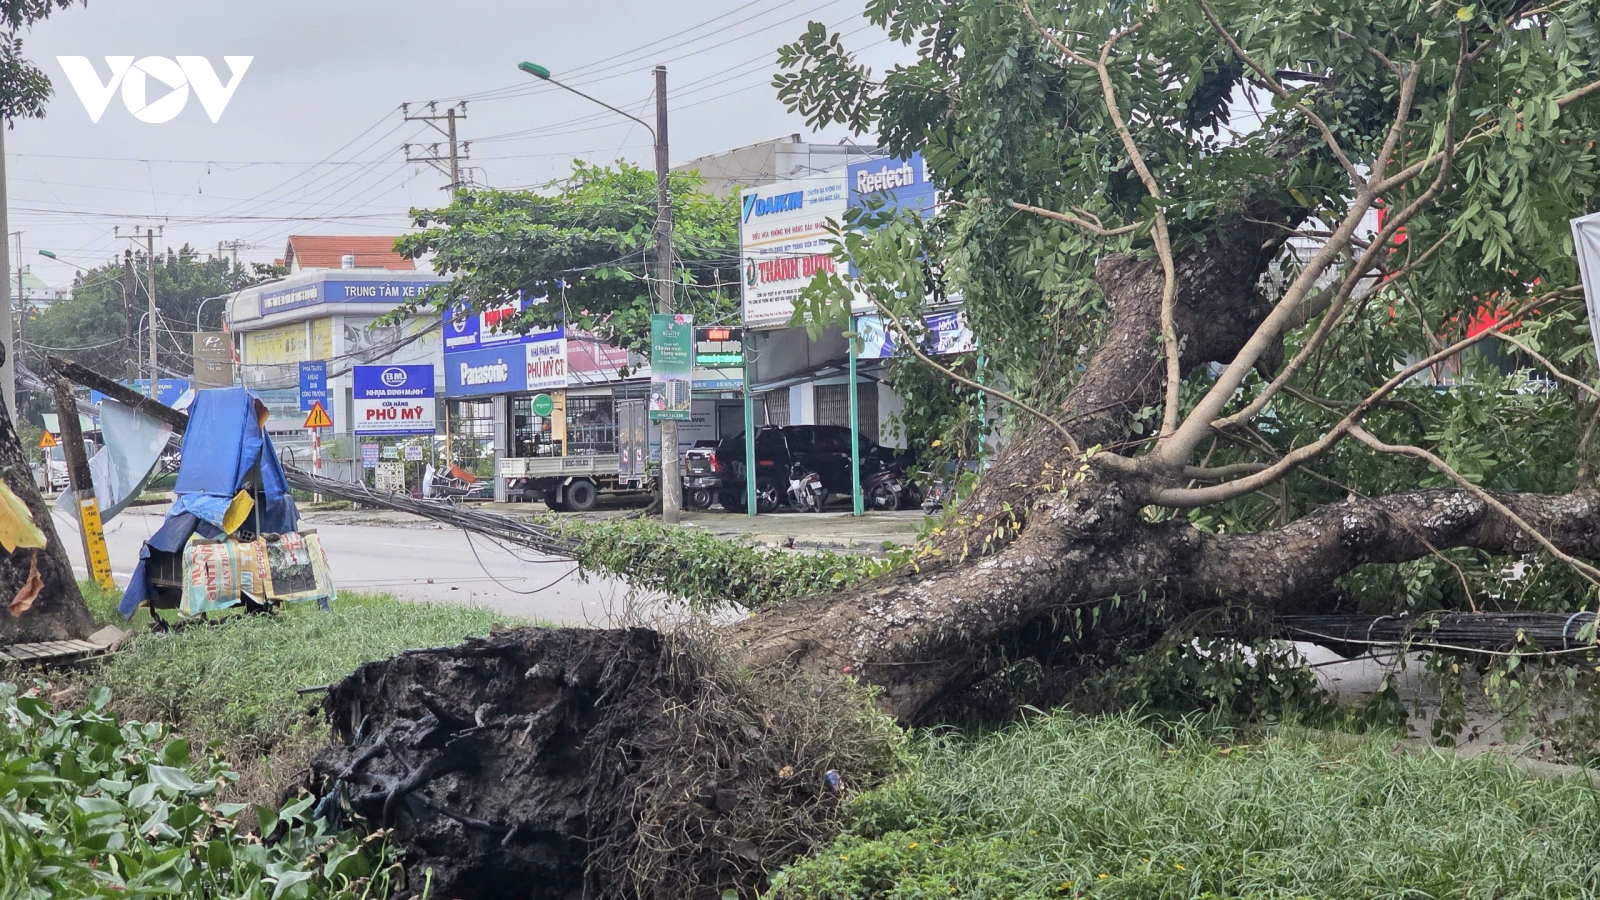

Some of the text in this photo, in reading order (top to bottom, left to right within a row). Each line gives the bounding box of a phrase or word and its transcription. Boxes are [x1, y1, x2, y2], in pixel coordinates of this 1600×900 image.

[857, 161, 914, 193] Reetech
[755, 191, 803, 216] DAIKIN
[344, 286, 376, 296] TRUNG
[379, 284, 399, 296] TÂM
[402, 286, 414, 296] XE
[460, 358, 509, 386] Panasonic
[527, 357, 542, 379] PHÚ
[543, 356, 554, 377] MỸ
[366, 406, 423, 420] PHÚ MỸ
